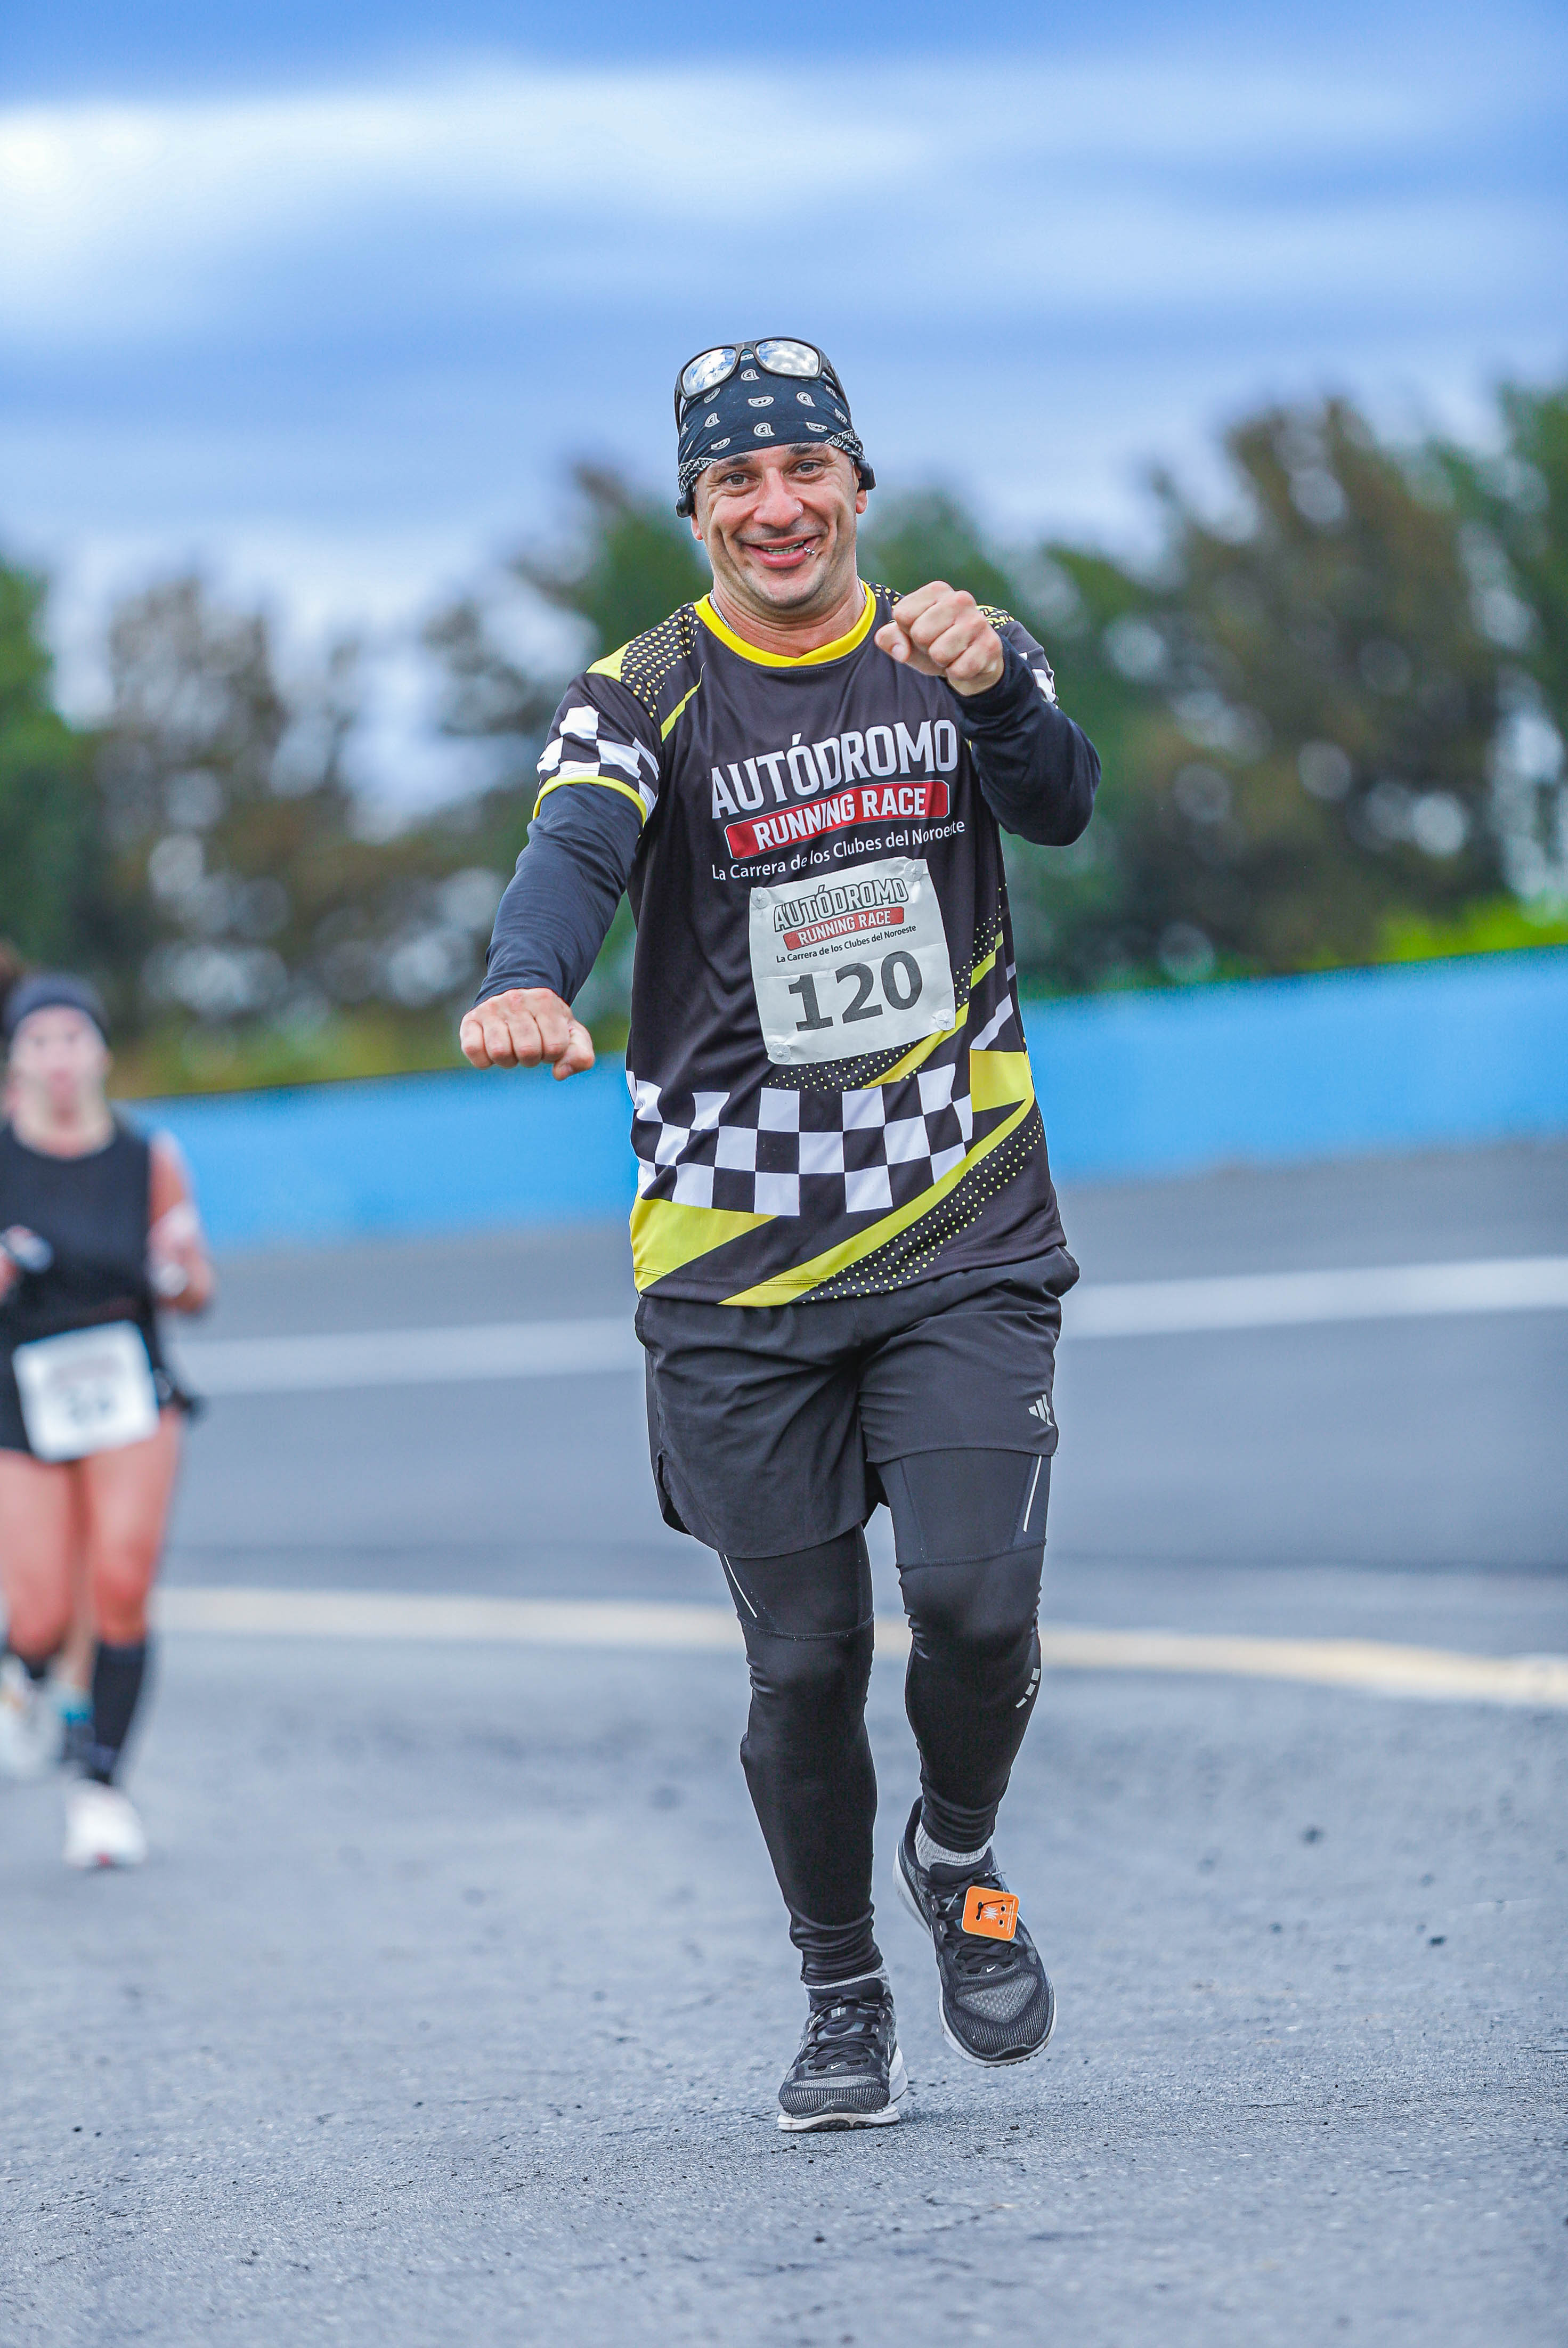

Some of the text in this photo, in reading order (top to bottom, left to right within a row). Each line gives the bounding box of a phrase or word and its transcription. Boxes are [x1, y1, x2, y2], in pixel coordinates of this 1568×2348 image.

[711, 719, 957, 819] AUTÓDROMO
[752, 787, 926, 850] RUNNING RACE
[712, 821, 965, 880] La Carrera de los Clubes del Noroeste
[774, 878, 908, 932] AUTÓDROMO
[798, 911, 891, 946] RUNNING RACE
[776, 924, 916, 963] La Carrera de los Clubes del Noroeste
[788, 951, 923, 1032] 120
